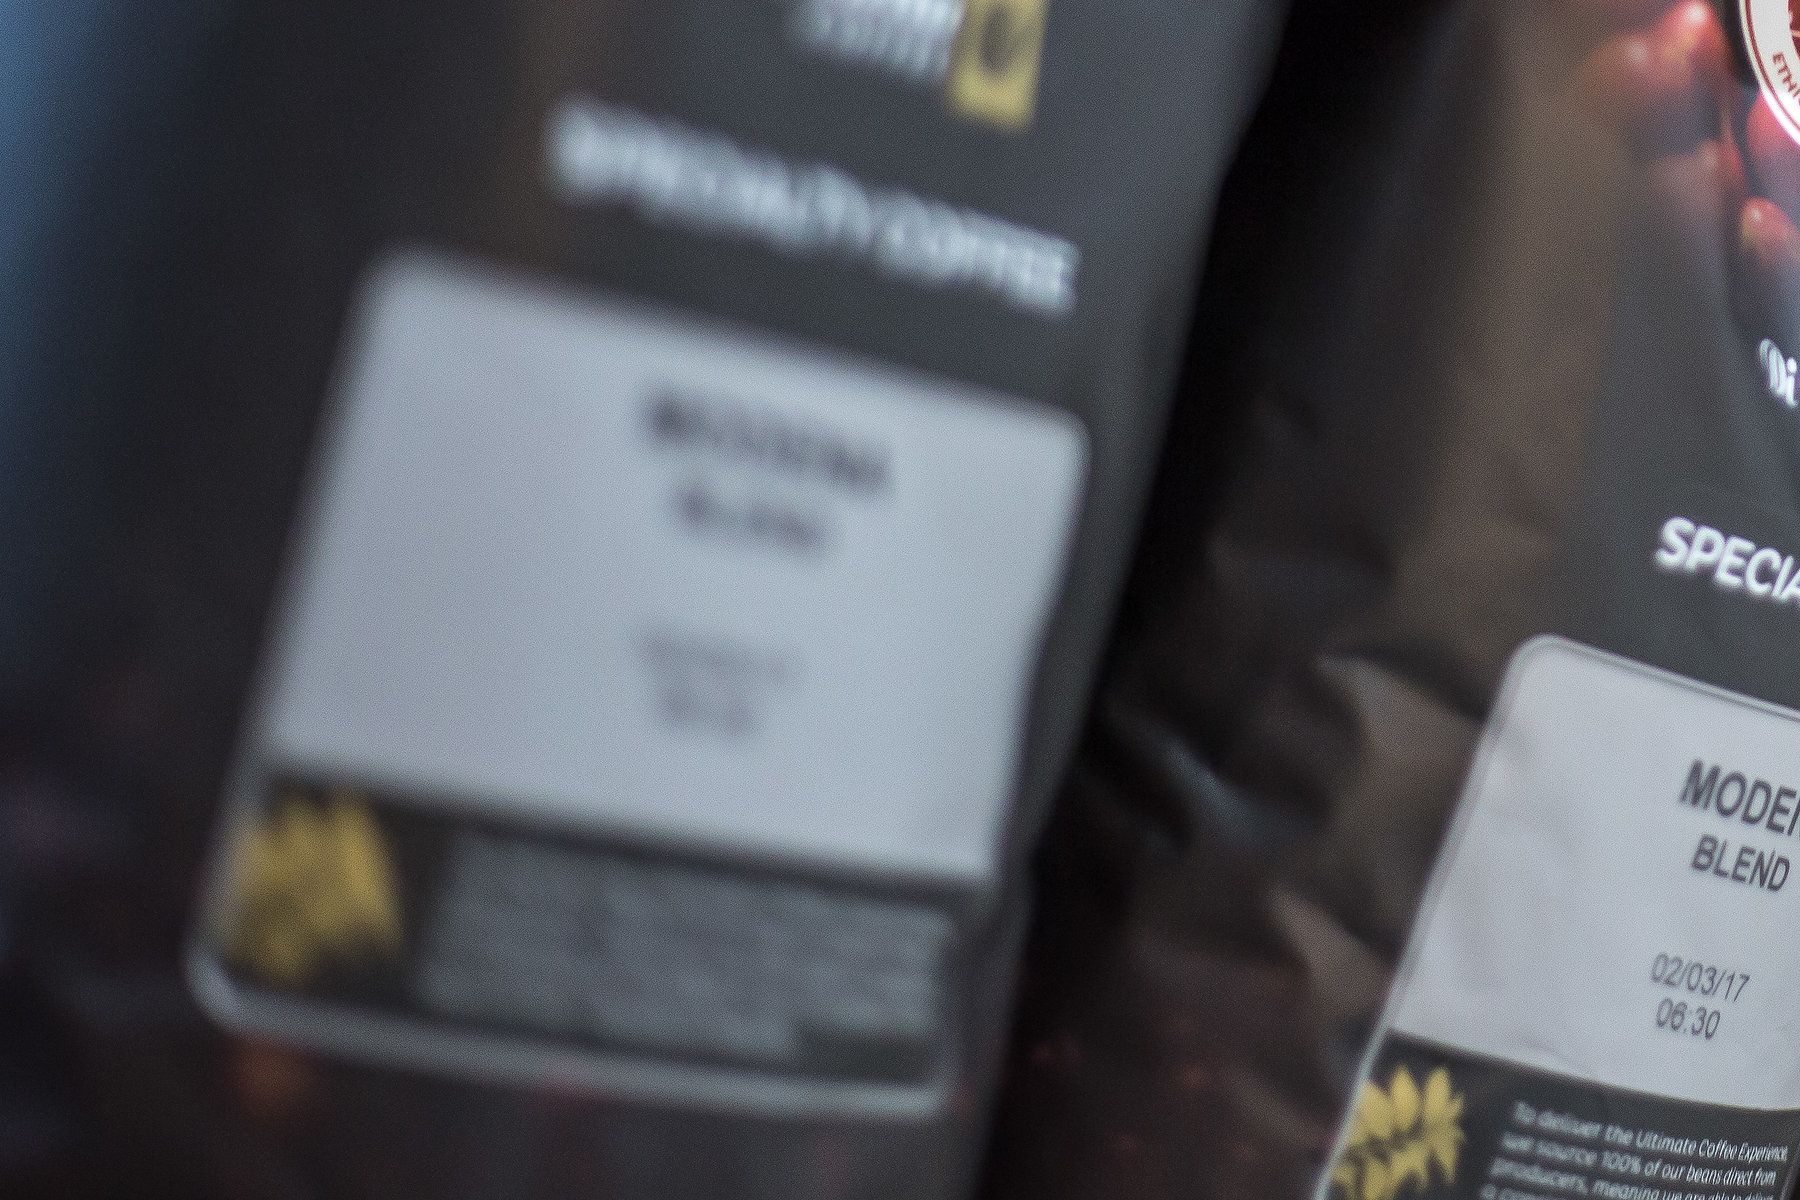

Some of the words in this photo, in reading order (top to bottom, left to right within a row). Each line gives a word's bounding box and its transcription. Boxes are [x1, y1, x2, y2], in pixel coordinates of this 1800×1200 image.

[1691, 832, 1792, 893] BLEND
[1651, 952, 1752, 1003] 02/03/17
[1605, 1125, 1634, 1147] the
[1635, 1128, 1697, 1157] Ultimate
[1698, 1137, 1739, 1161] Coffee
[1644, 1158, 1662, 1177] of
[1661, 1163, 1685, 1181] our
[1686, 1163, 1723, 1186] beans
[1723, 1166, 1752, 1187] direct
[1753, 1166, 1777, 1187] from
